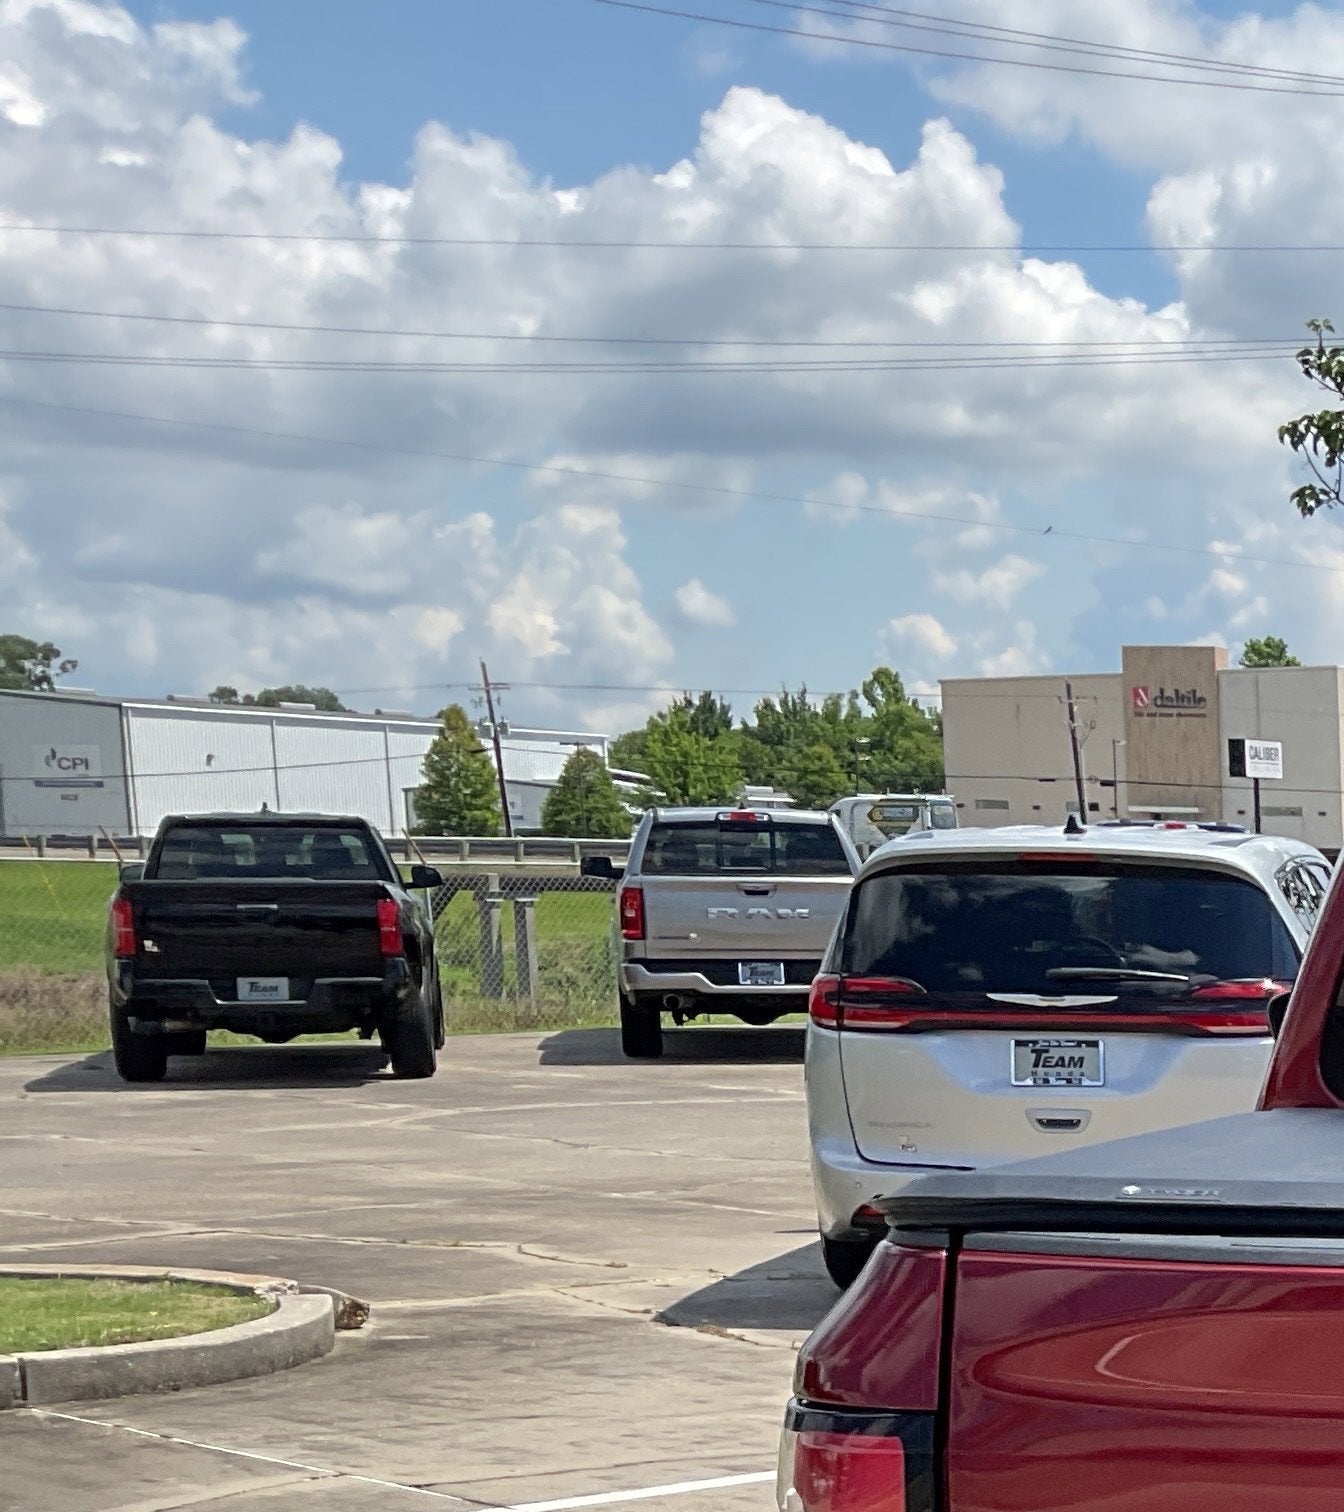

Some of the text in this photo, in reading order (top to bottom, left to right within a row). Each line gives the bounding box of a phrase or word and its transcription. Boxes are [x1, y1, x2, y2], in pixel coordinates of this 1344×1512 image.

[1154, 688, 1207, 708] daltile
[1249, 746, 1280, 762] CALIBER
[57, 757, 89, 770] CPI
[707, 907, 810, 919] RAM
[1031, 1048, 1085, 1068] TEAM
